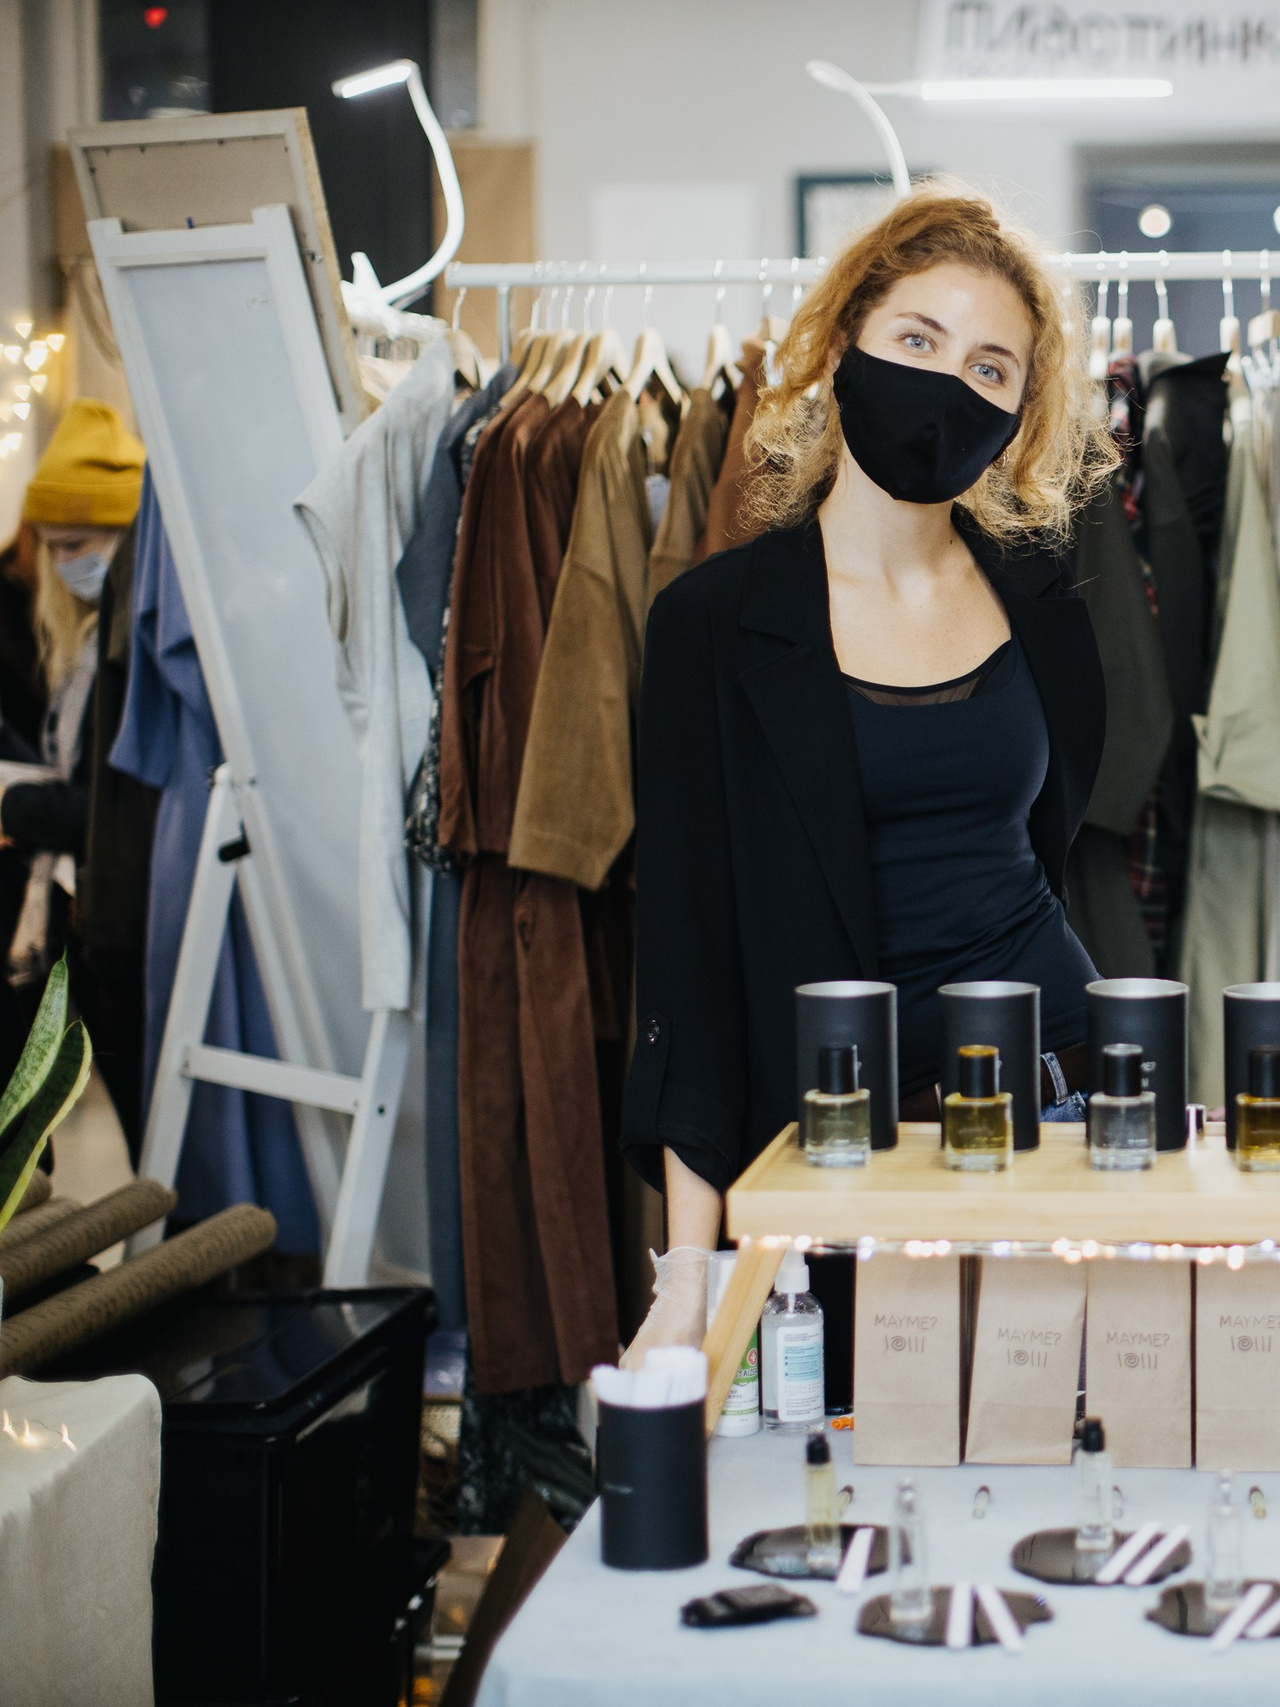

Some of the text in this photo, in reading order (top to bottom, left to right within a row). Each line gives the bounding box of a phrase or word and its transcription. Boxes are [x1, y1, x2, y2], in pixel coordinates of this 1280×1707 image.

[874, 1314, 938, 1330] MAYME?
[997, 1327, 1062, 1346] MAYME?
[1106, 1331, 1170, 1347] MAYME?
